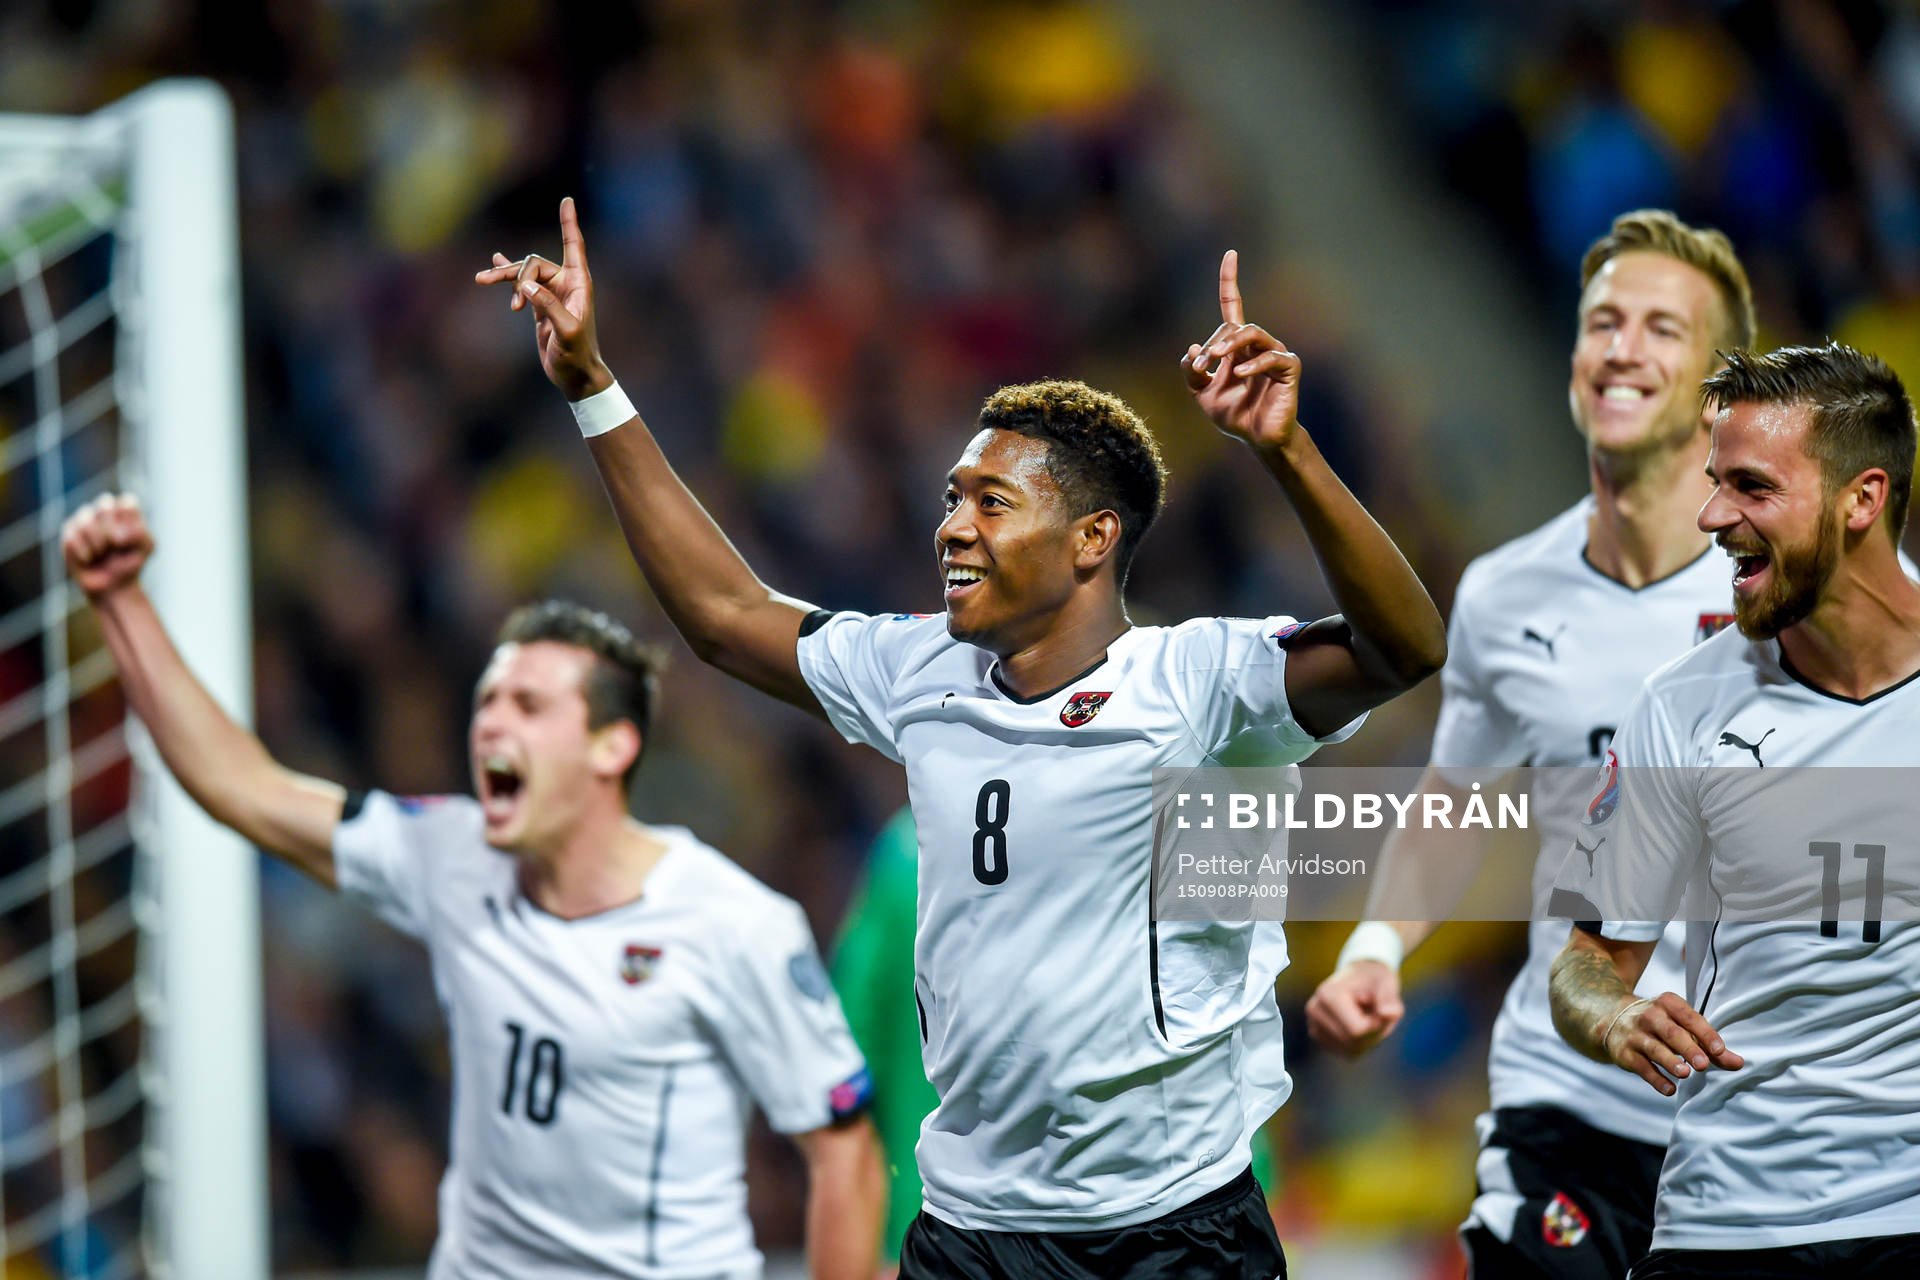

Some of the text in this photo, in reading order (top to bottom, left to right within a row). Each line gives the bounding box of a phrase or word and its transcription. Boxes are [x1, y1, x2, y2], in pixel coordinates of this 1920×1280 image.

[972, 779, 1010, 885] 8
[1808, 841, 1886, 943] 11
[501, 1021, 564, 1126] 10
